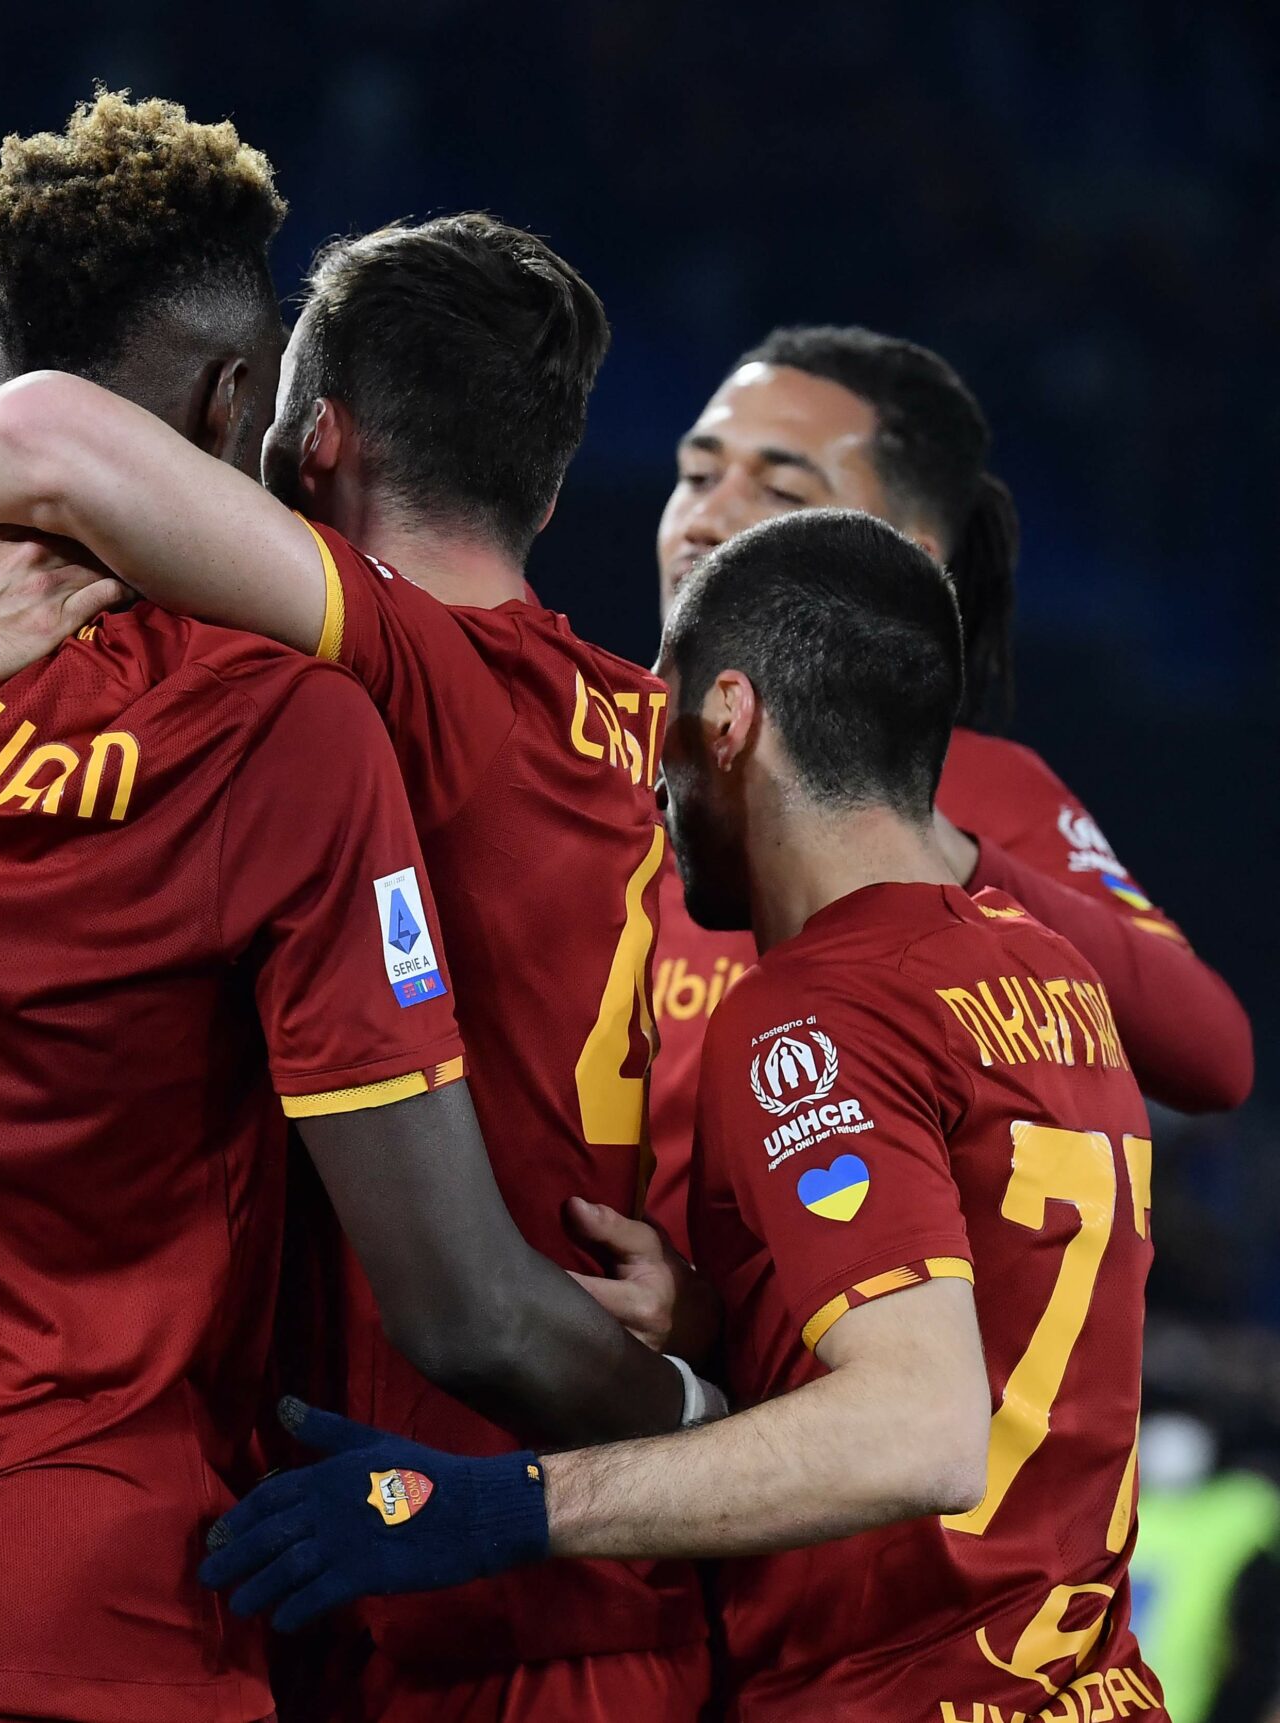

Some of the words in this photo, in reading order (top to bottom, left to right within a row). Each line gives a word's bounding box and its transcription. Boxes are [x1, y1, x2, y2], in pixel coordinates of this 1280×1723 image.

[393, 957, 422, 977] SERIE
[423, 955, 431, 971] A
[415, 976, 437, 994] TIM
[751, 1037, 758, 1048] A
[758, 1019, 803, 1043] sostegno
[806, 1015, 817, 1025] di
[763, 1099, 864, 1157] UNHCR
[795, 1136, 814, 1152] ONU
[815, 1130, 831, 1143] per
[837, 1119, 875, 1134] Rifugiati
[404, 1471, 423, 1506] ROMA
